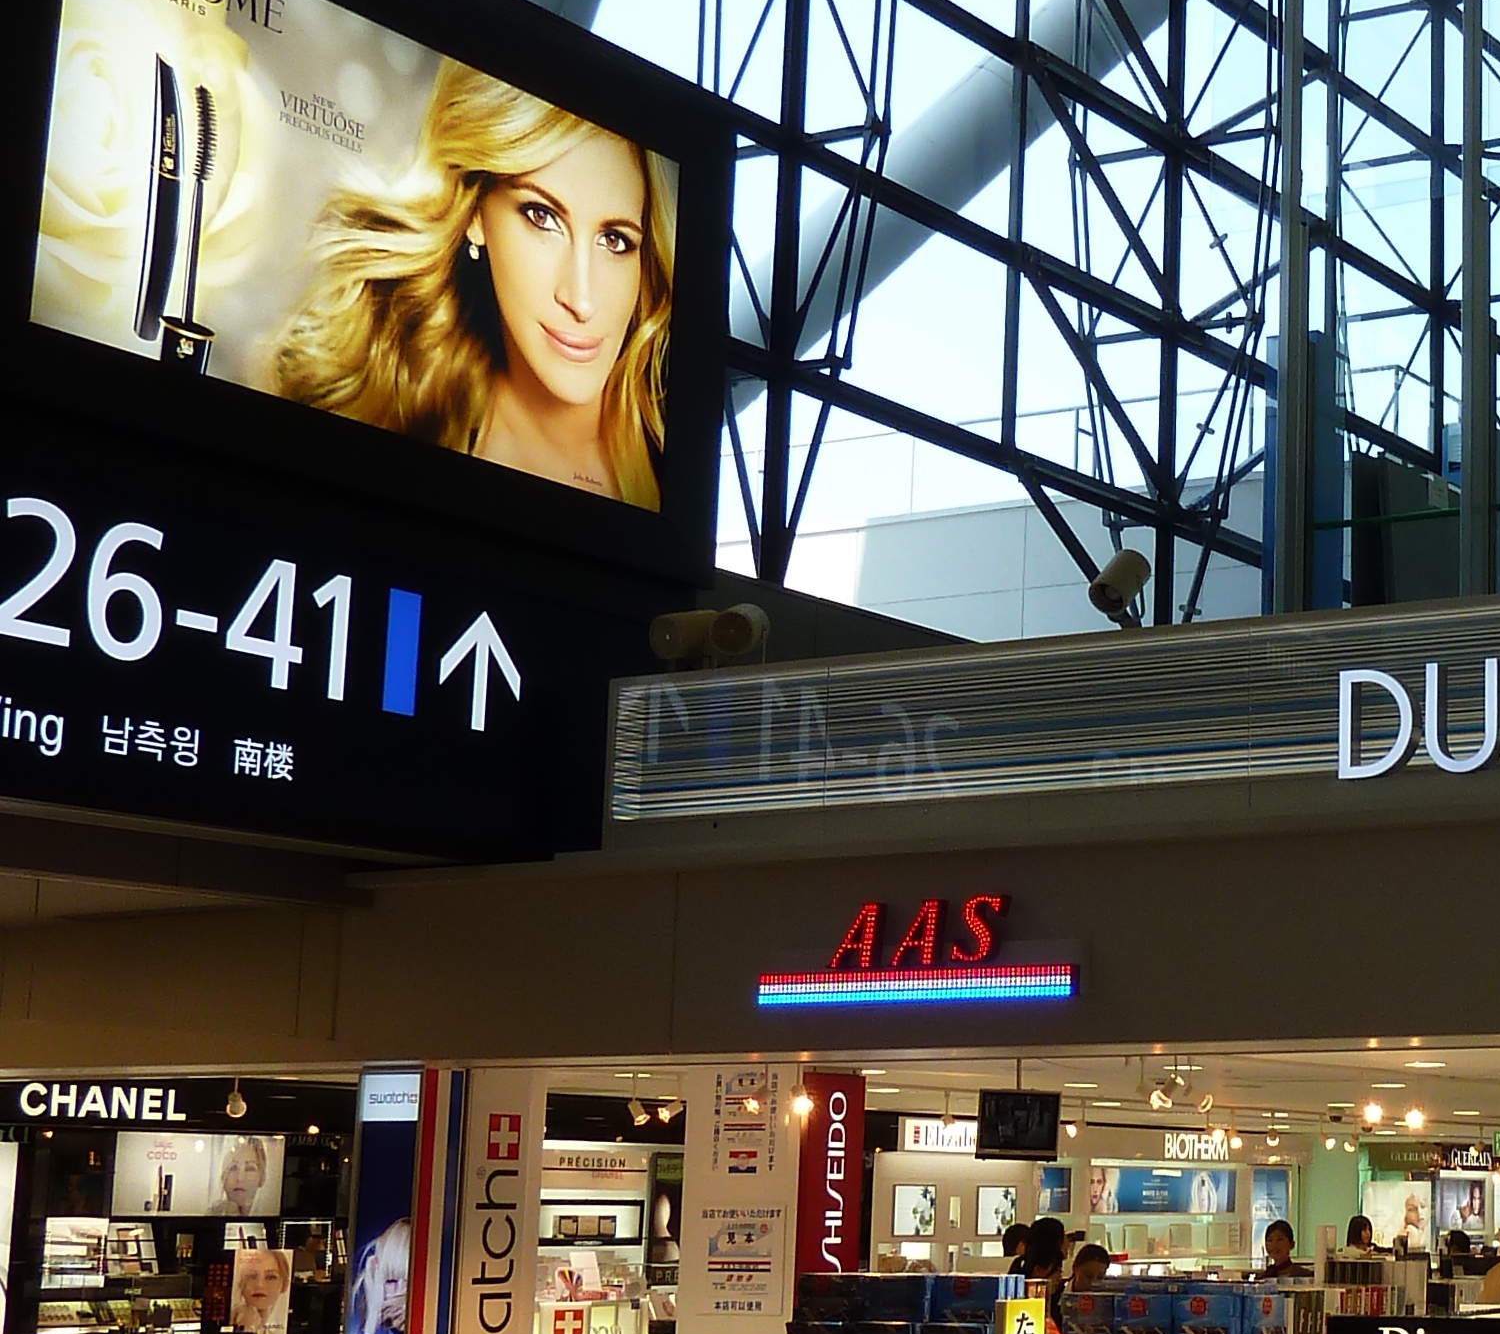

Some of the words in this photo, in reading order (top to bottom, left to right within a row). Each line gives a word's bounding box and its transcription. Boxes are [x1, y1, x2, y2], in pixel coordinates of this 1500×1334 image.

[281, 90, 364, 140] VIRTUÔSE
[313, 94, 336, 109] NEW
[280, 111, 330, 141] PRECIOUS
[332, 134, 362, 153] CELLS
[0, 497, 352, 701] 26-41
[0, 697, 64, 757] ing
[101, 714, 201, 768] 남측윙
[233, 737, 295, 781] 南楼
[828, 894, 1011, 968] AAS
[20, 1082, 187, 1121] CHANEL
[368, 1090, 409, 1105] swatch
[559, 1156, 627, 1168] PRÉCISION
[1164, 1132, 1230, 1160] BIOTHERM
[821, 1091, 848, 1274] SHISEIDO
